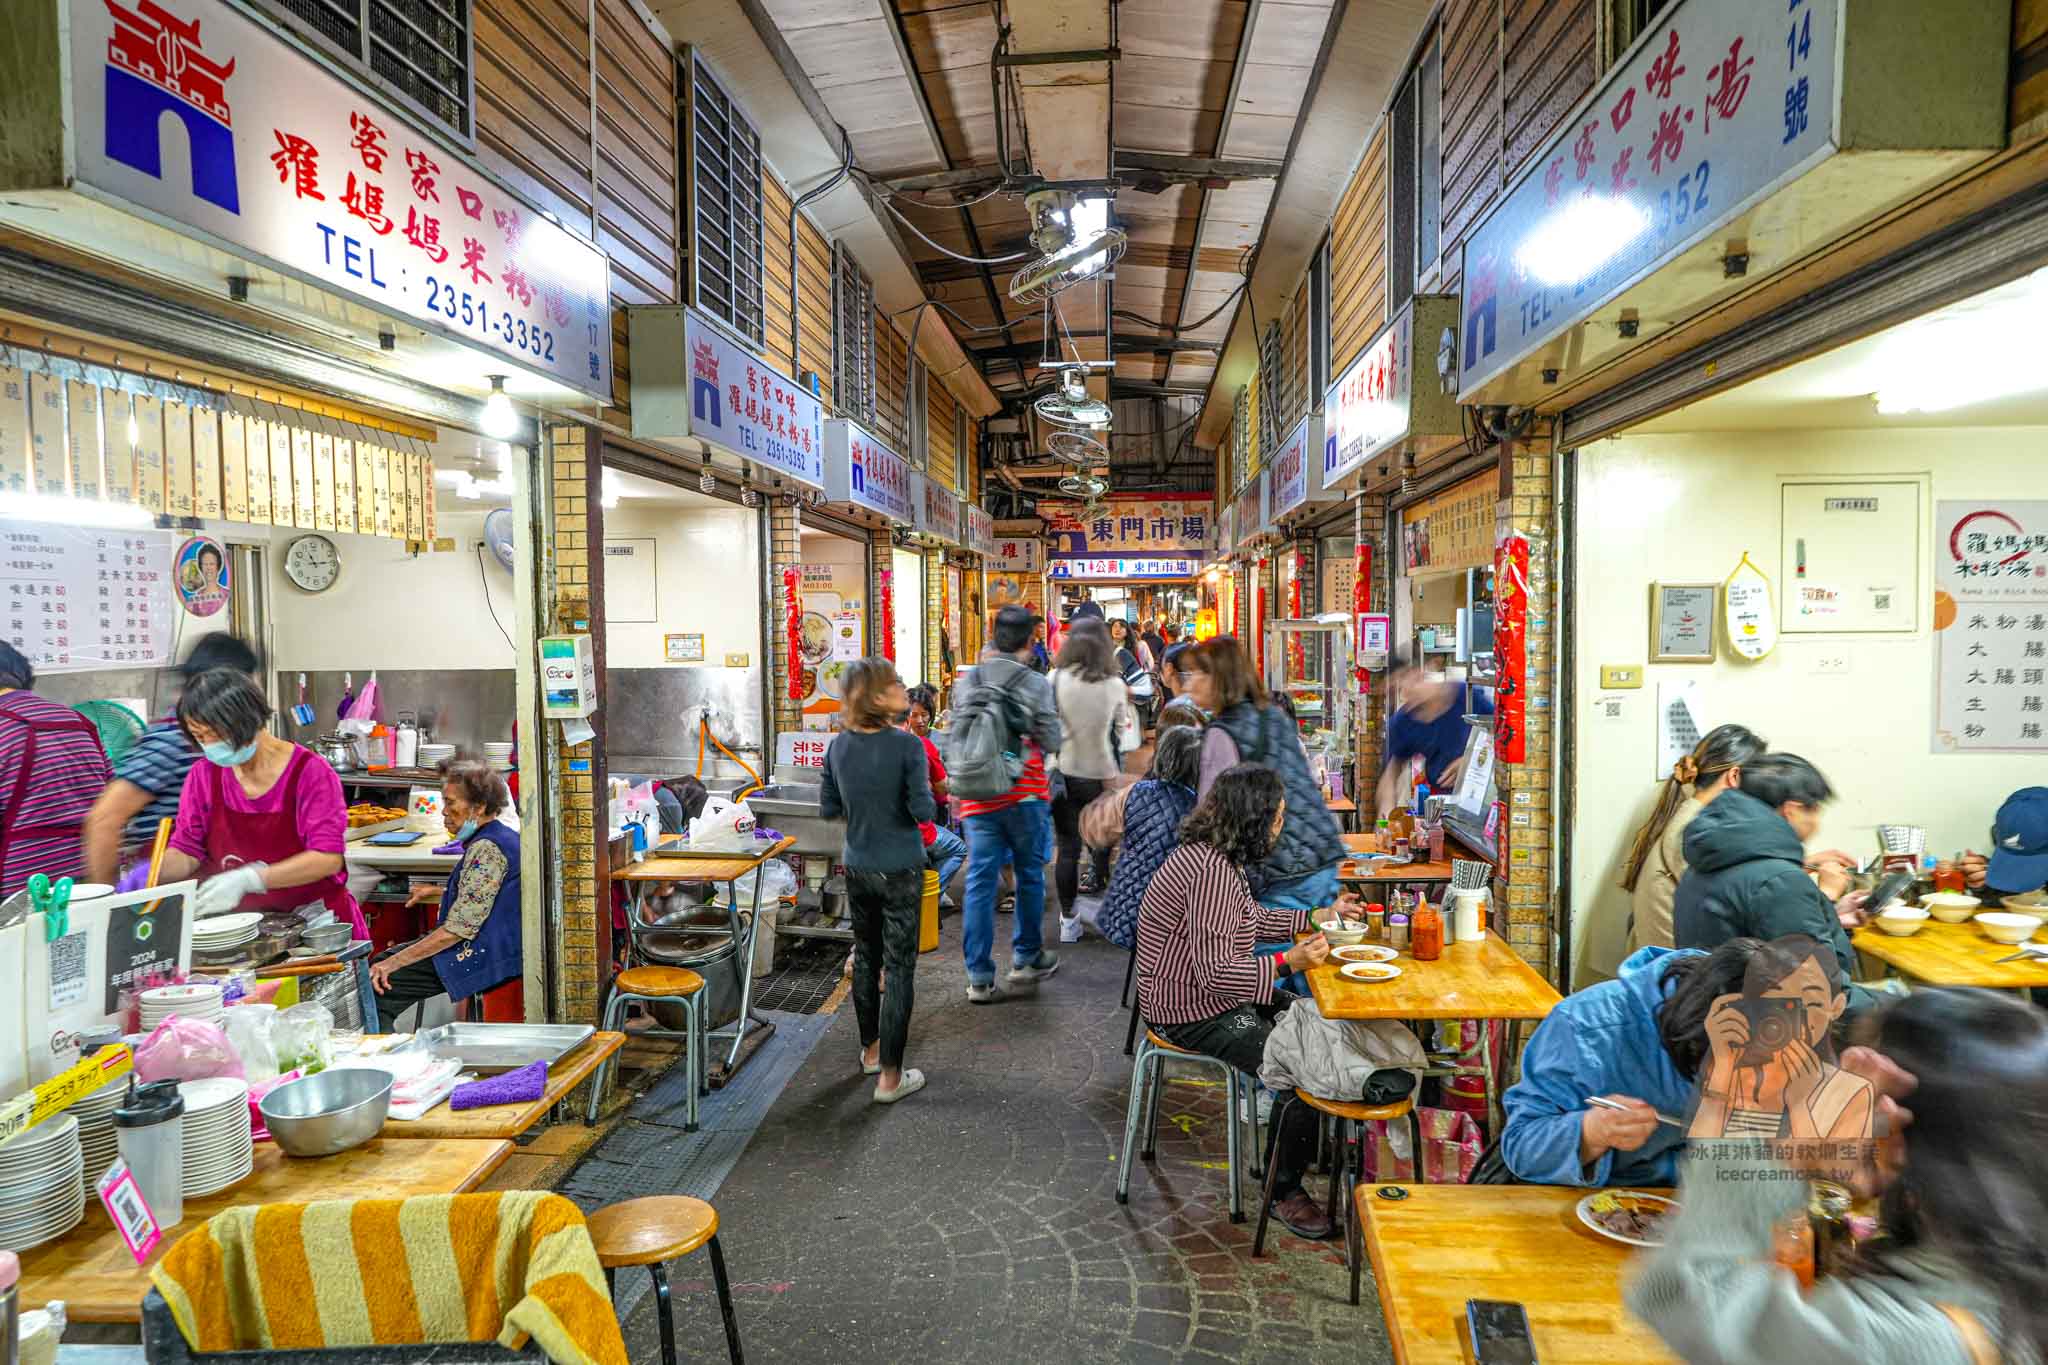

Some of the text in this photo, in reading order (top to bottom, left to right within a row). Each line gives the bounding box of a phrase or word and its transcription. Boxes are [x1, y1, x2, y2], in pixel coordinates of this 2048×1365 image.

[426, 276, 555, 363] 2351-3352
[746, 362, 798, 418] 客家口味
[728, 383, 811, 454] 羅媽媽米粉湯
[766, 437, 806, 471] 2351-3352
[1091, 516, 1205, 542] 東門市場
[1967, 532, 2048, 554] 羅媽媽
[1134, 560, 1189, 574] 東門市場
[1967, 613, 2048, 632] 米粉湯
[1967, 641, 2047, 657] 大腸
[1966, 668, 2045, 685] 大腸頭
[1965, 695, 2044, 713] 生腸
[1964, 723, 2043, 740] 粉腸
[131, 951, 157, 966] 2024
